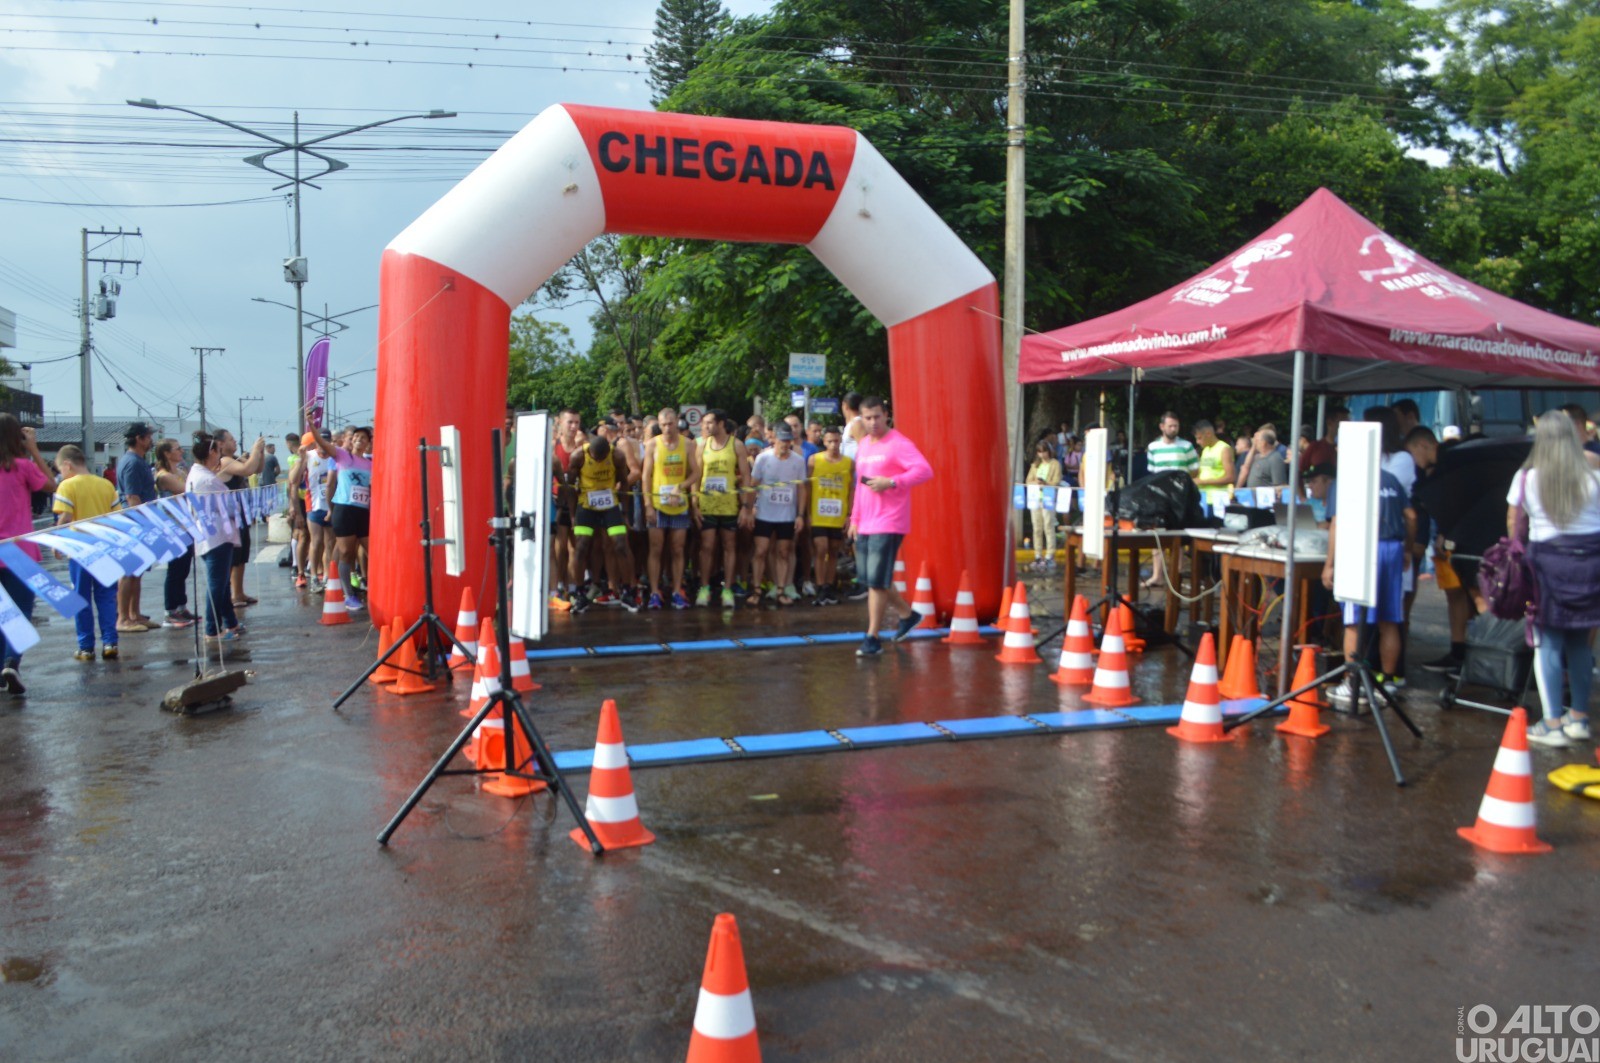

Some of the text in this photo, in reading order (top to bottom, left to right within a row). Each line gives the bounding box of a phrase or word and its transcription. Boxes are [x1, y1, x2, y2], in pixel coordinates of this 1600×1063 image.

[598, 131, 835, 191] CHEGADA
[1060, 323, 1228, 362] www.maratonadovinho.com.br
[1388, 328, 1600, 367] www.maratonadovinho.com.br
[690, 412, 697, 422] E
[352, 492, 369, 502] 617
[590, 497, 612, 507] 665
[819, 505, 839, 514] 509
